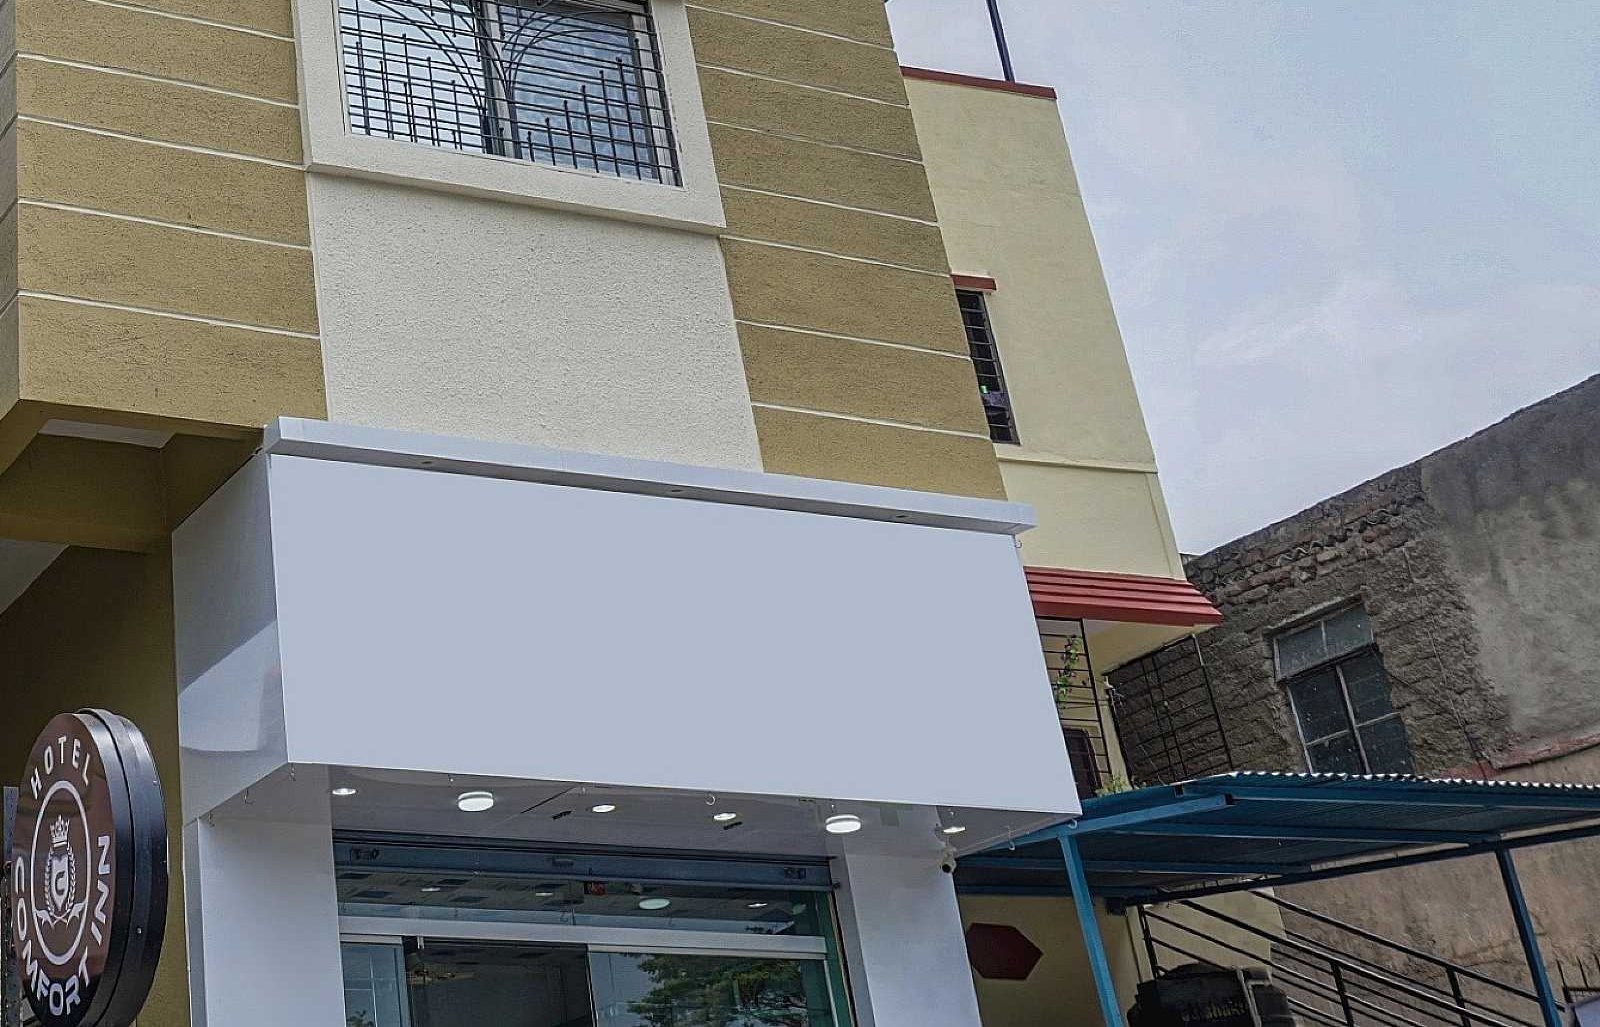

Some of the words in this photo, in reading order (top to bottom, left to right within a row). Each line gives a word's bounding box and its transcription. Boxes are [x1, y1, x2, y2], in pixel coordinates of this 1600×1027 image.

[30, 736, 92, 799] HOTEL
[15, 855, 91, 1017] COMFORT
[91, 834, 112, 946] INN
